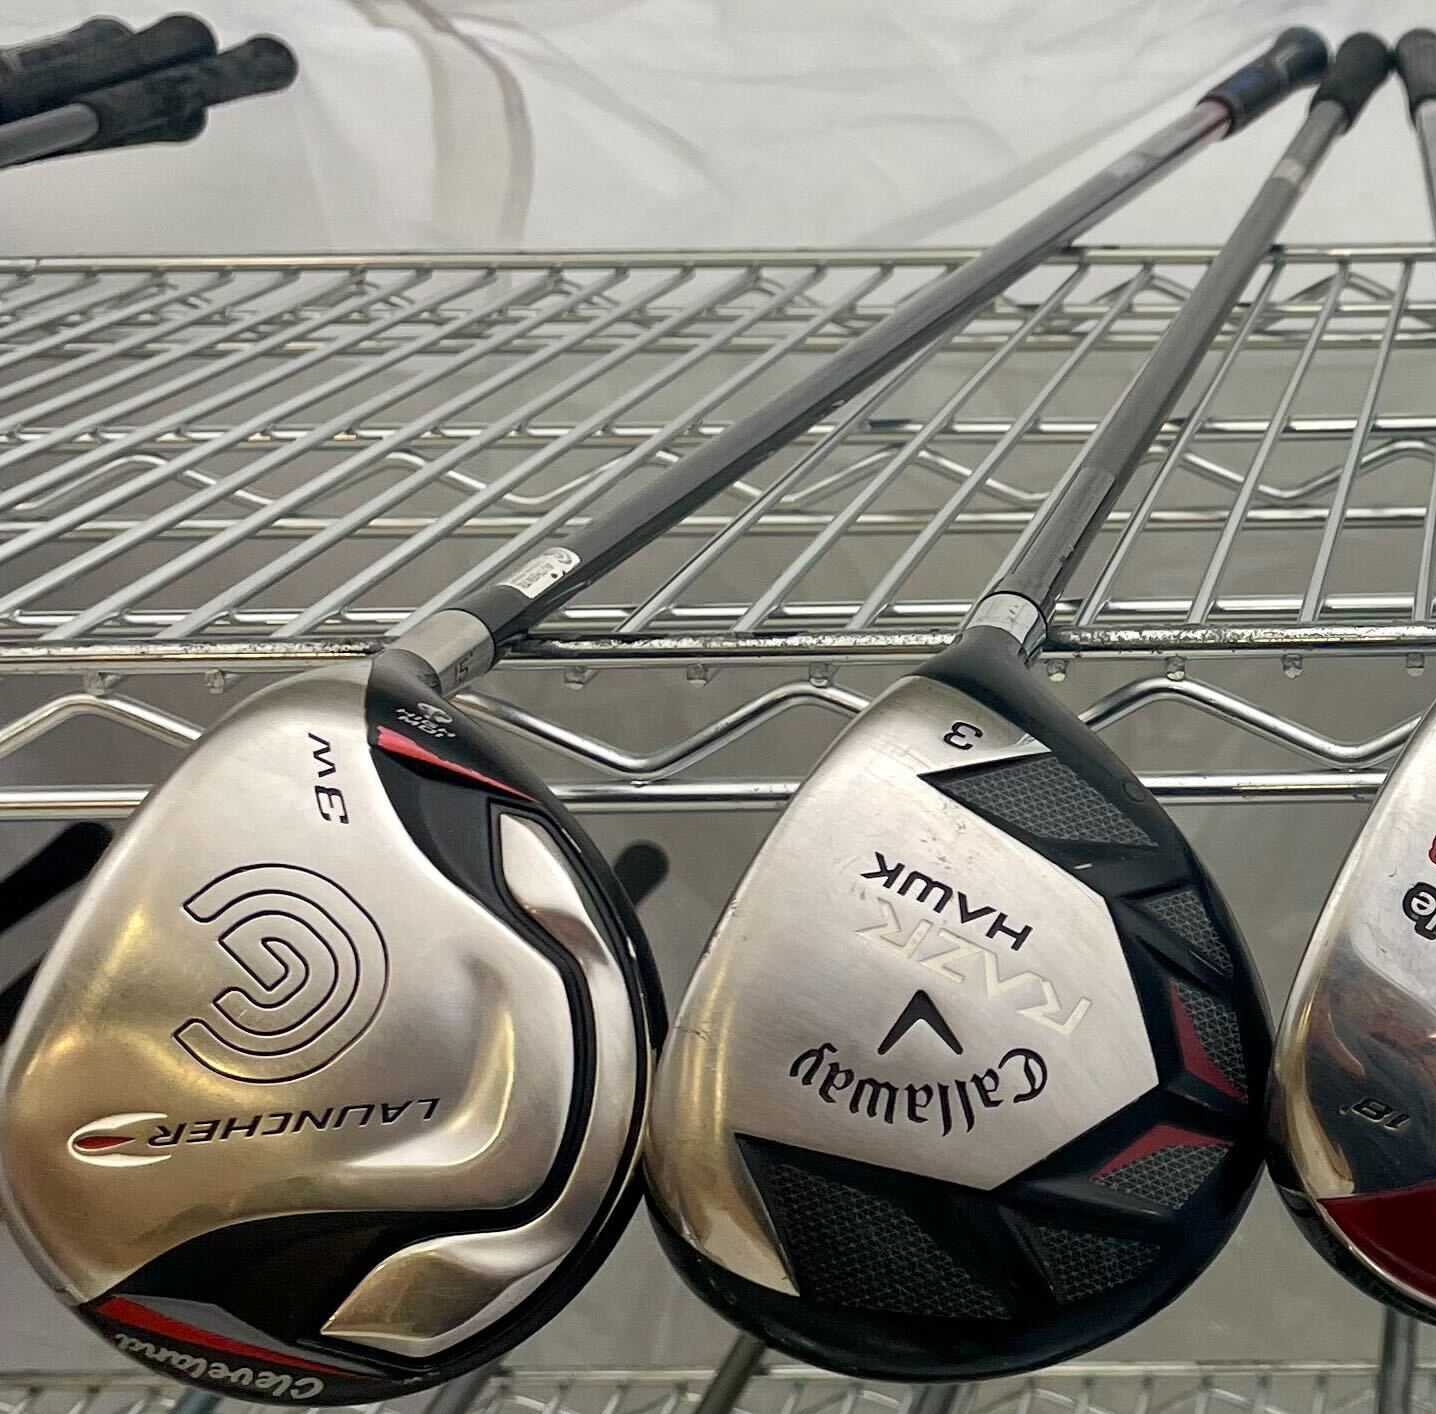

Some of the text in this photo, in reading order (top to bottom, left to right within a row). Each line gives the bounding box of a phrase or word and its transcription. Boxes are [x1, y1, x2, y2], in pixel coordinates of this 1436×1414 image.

[308, 733, 350, 825] 3W
[943, 721, 984, 751] 3
[860, 851, 1033, 952] HAWK
[855, 899, 1093, 1038] RAZR
[148, 1098, 441, 1149] LAUNCHER
[790, 1042, 1049, 1138] Callaway
[113, 1333, 325, 1399] Cleveland
